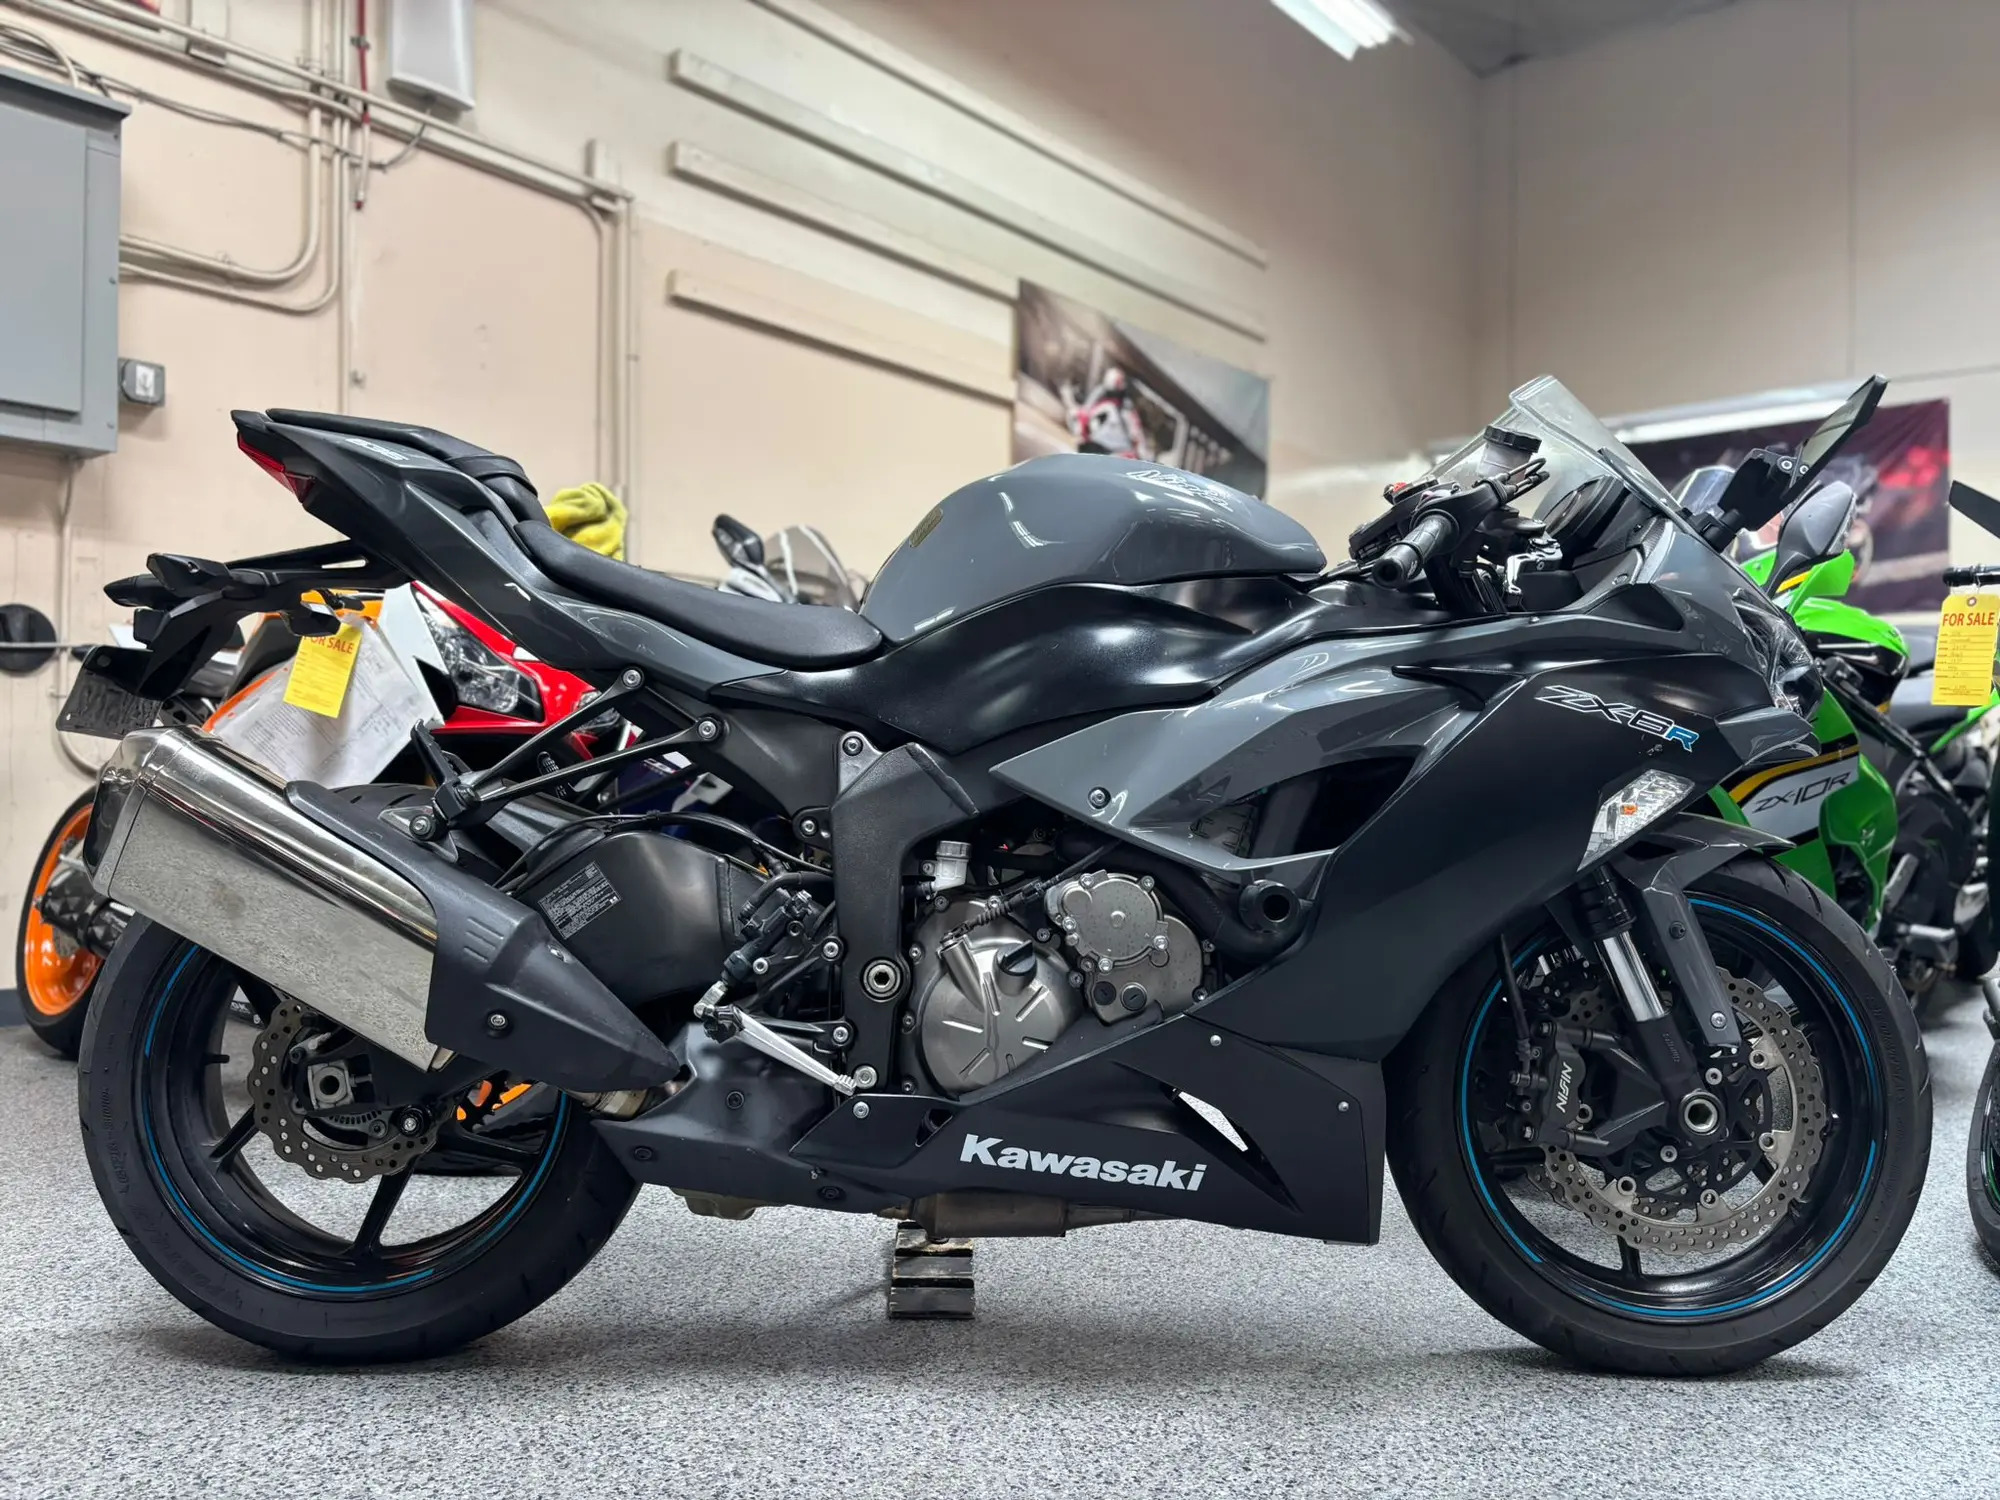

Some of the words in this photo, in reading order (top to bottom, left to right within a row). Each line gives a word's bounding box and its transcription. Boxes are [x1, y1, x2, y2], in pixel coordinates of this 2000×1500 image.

[1942, 612, 1965, 627] FOR
[1966, 612, 1996, 626] SALE
[327, 636, 355, 655] SALE
[1751, 771, 1852, 815] ZX-10R
[959, 1133, 1207, 1192] Kawasaki
